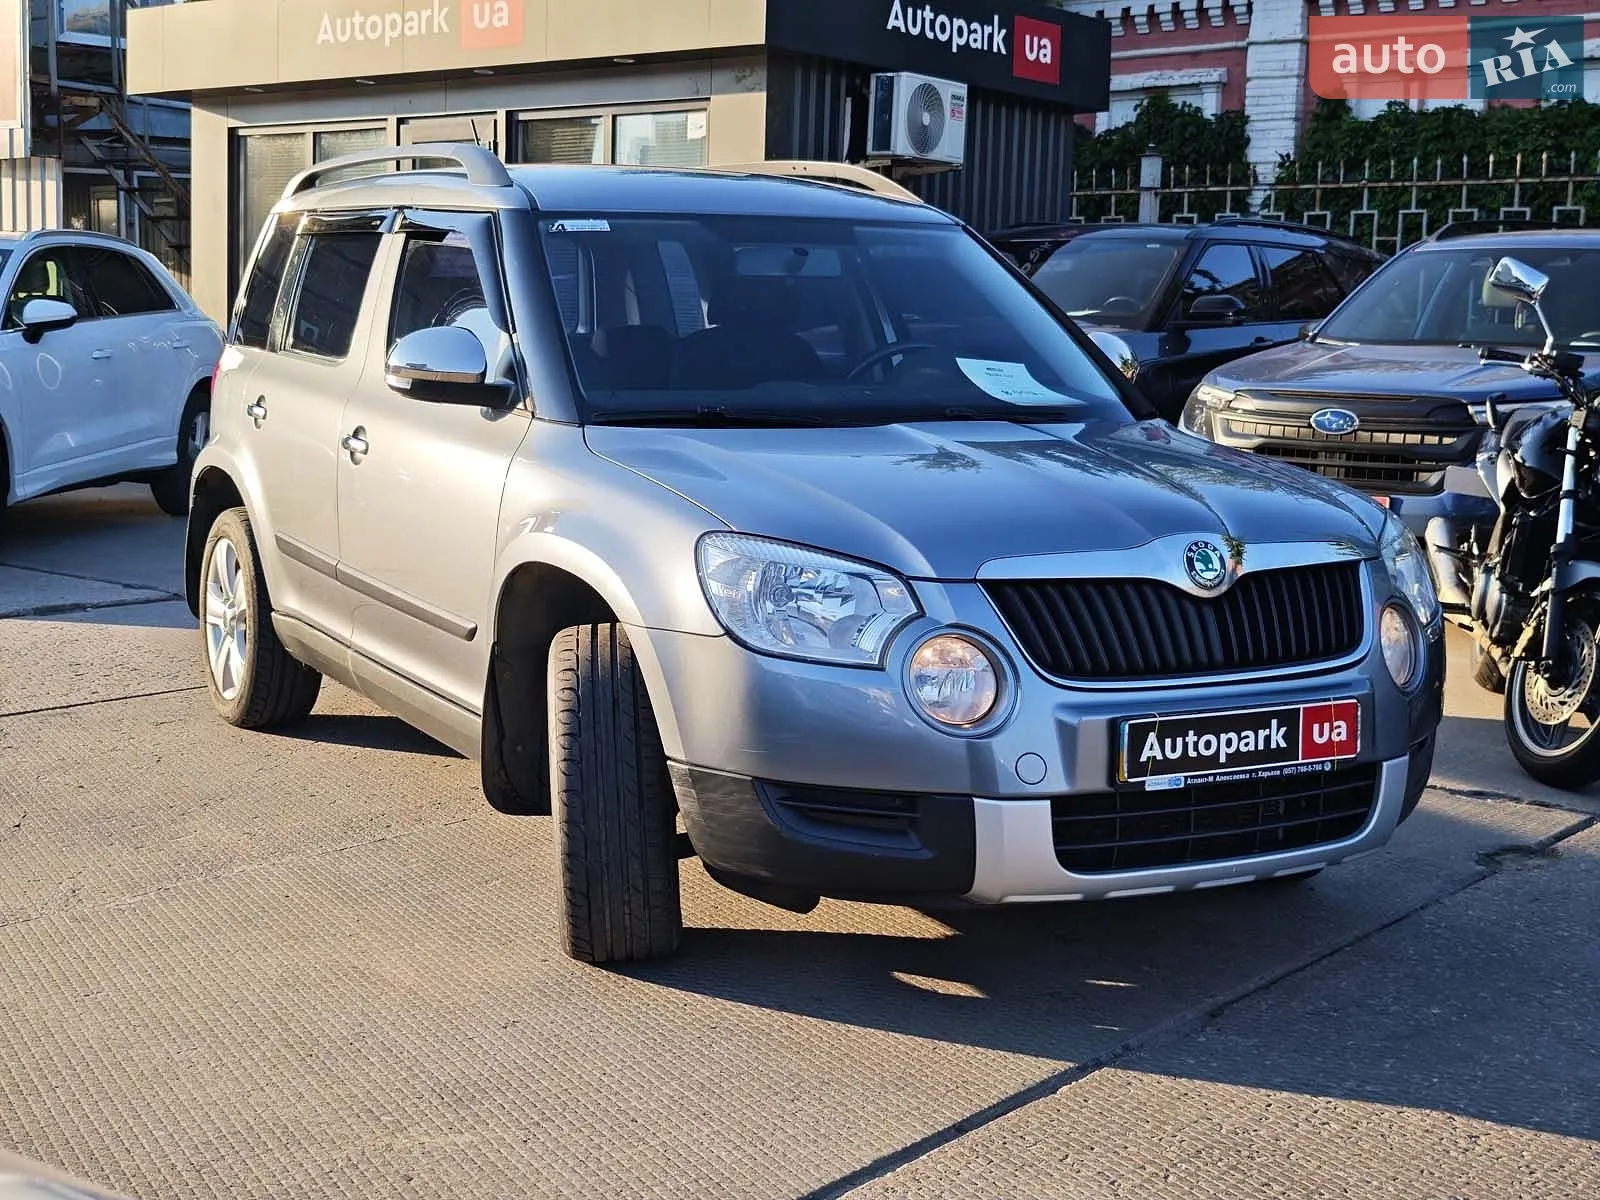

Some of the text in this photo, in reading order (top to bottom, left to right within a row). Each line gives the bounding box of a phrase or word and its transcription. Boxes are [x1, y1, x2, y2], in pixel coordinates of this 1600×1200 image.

[316, 0, 509, 48] Autopark ua
[887, 0, 1052, 65] Autopark ua
[1139, 718, 1348, 763] Autopark ua
